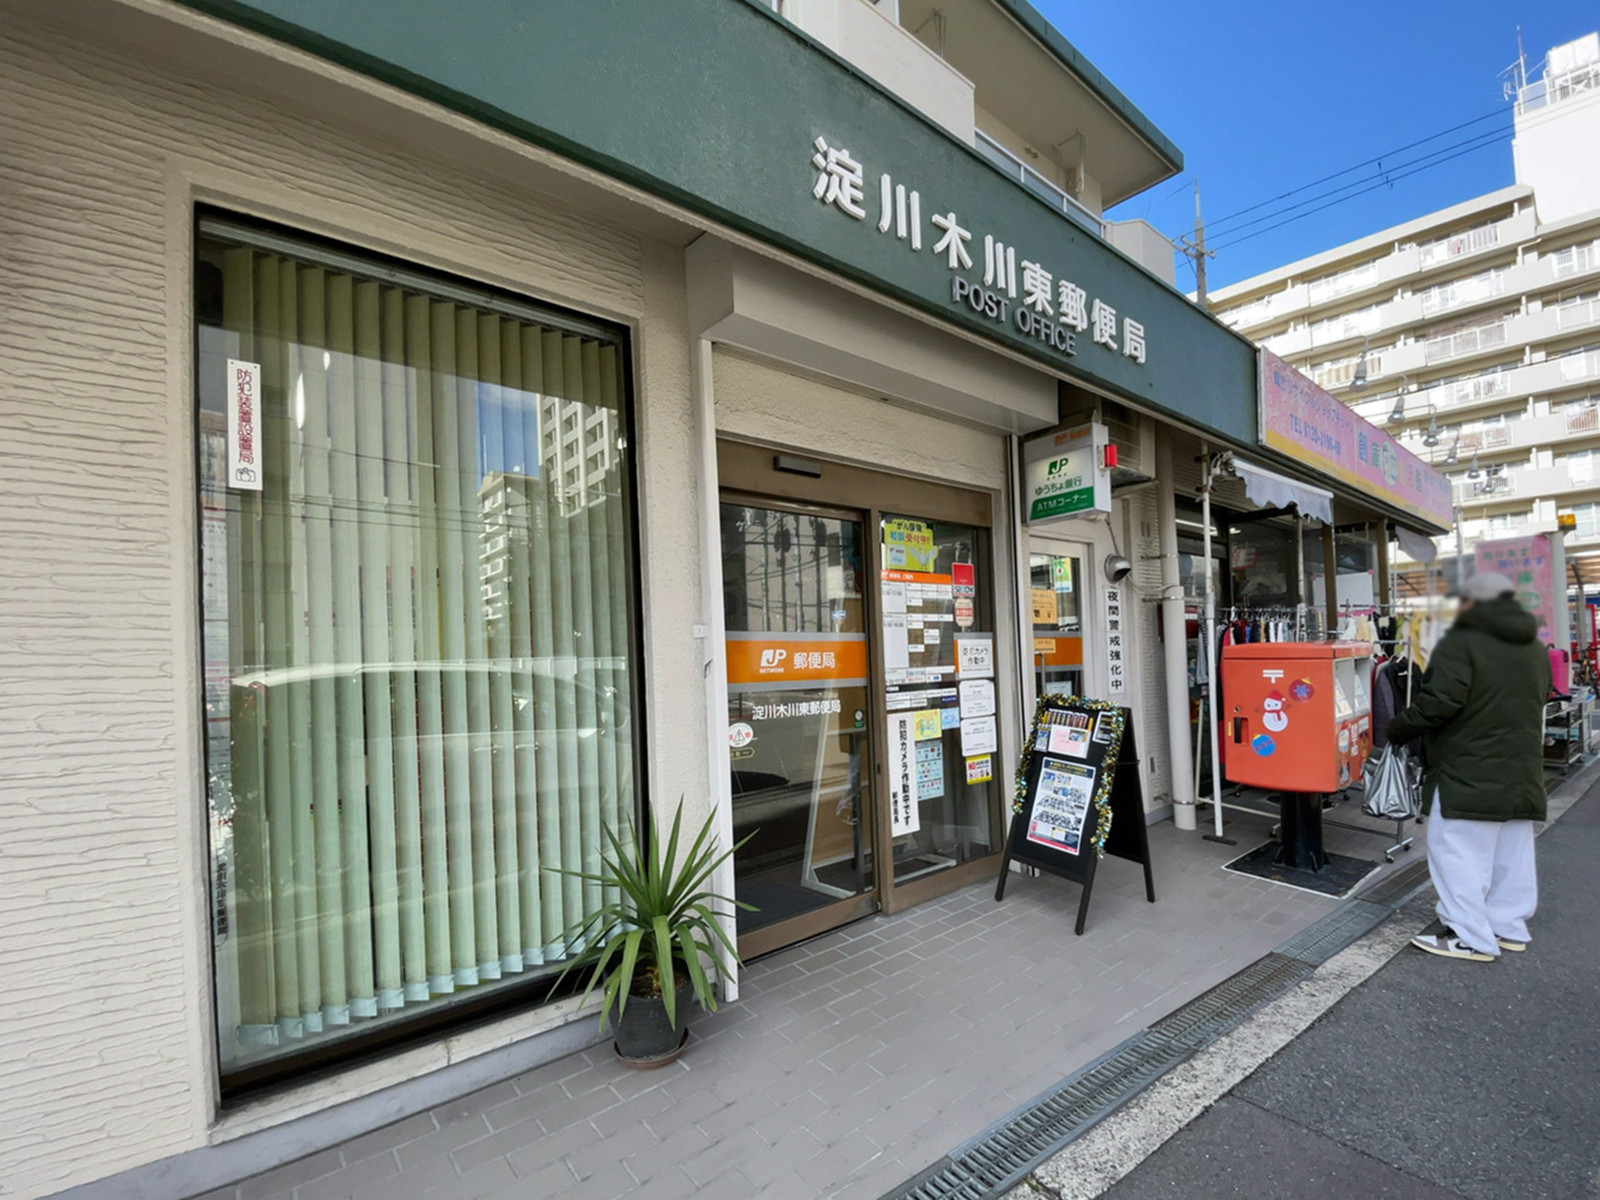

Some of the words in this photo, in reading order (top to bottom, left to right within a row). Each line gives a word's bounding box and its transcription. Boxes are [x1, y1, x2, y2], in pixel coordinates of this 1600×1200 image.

[812, 136, 1147, 364] 淀川木川東郵便局
[953, 275, 1009, 323] POST
[1014, 306, 1077, 357] OFFICE
[1048, 457, 1069, 476] JP
[1035, 475, 1082, 496] ゆうちょ銀行
[1036, 493, 1088, 512] ATMコーナー
[1107, 590, 1122, 690] 夜間警戒強化中
[761, 649, 786, 667] JP
[793, 651, 835, 669] 郵便局
[752, 700, 841, 720] 淀川木川東郵便局
